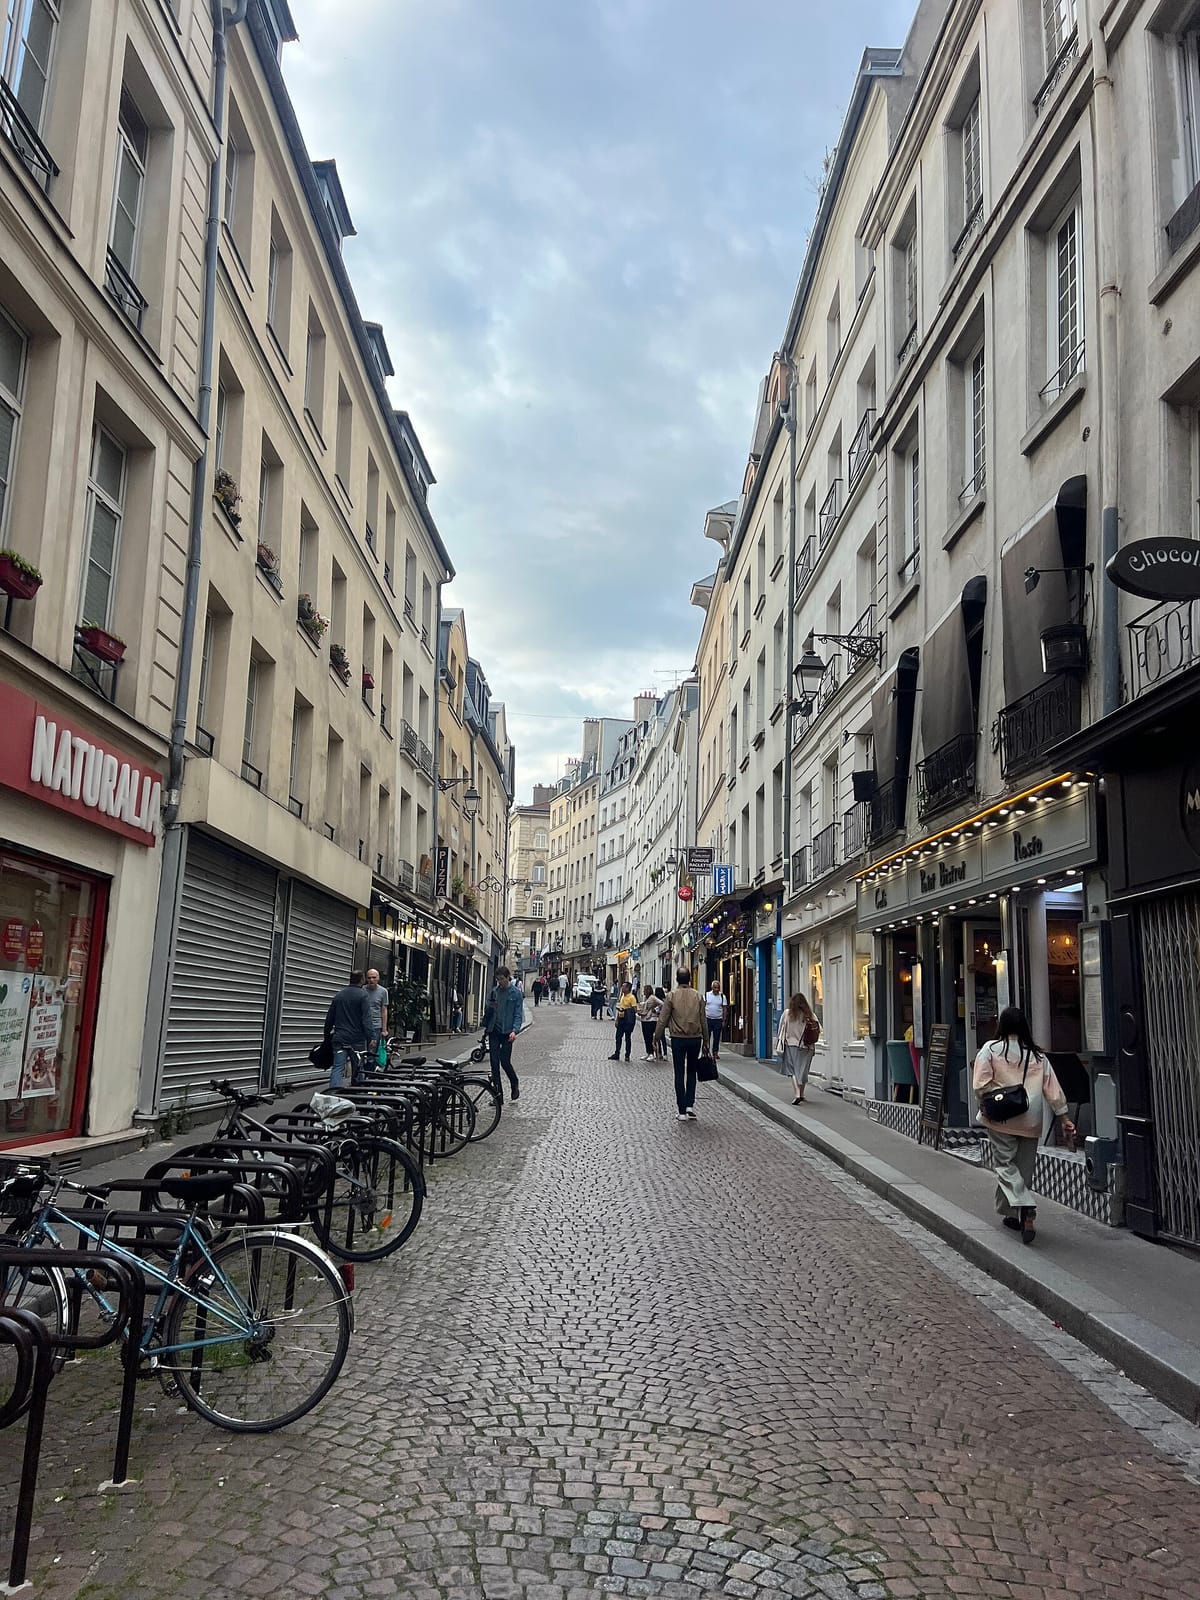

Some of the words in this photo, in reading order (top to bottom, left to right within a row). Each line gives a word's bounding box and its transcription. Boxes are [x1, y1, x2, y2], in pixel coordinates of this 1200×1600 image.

[30, 715, 161, 838] NATURALIA
[1013, 831, 1042, 862] Resto
[437, 850, 447, 896] PIZZA
[939, 860, 966, 888] Bistrot
